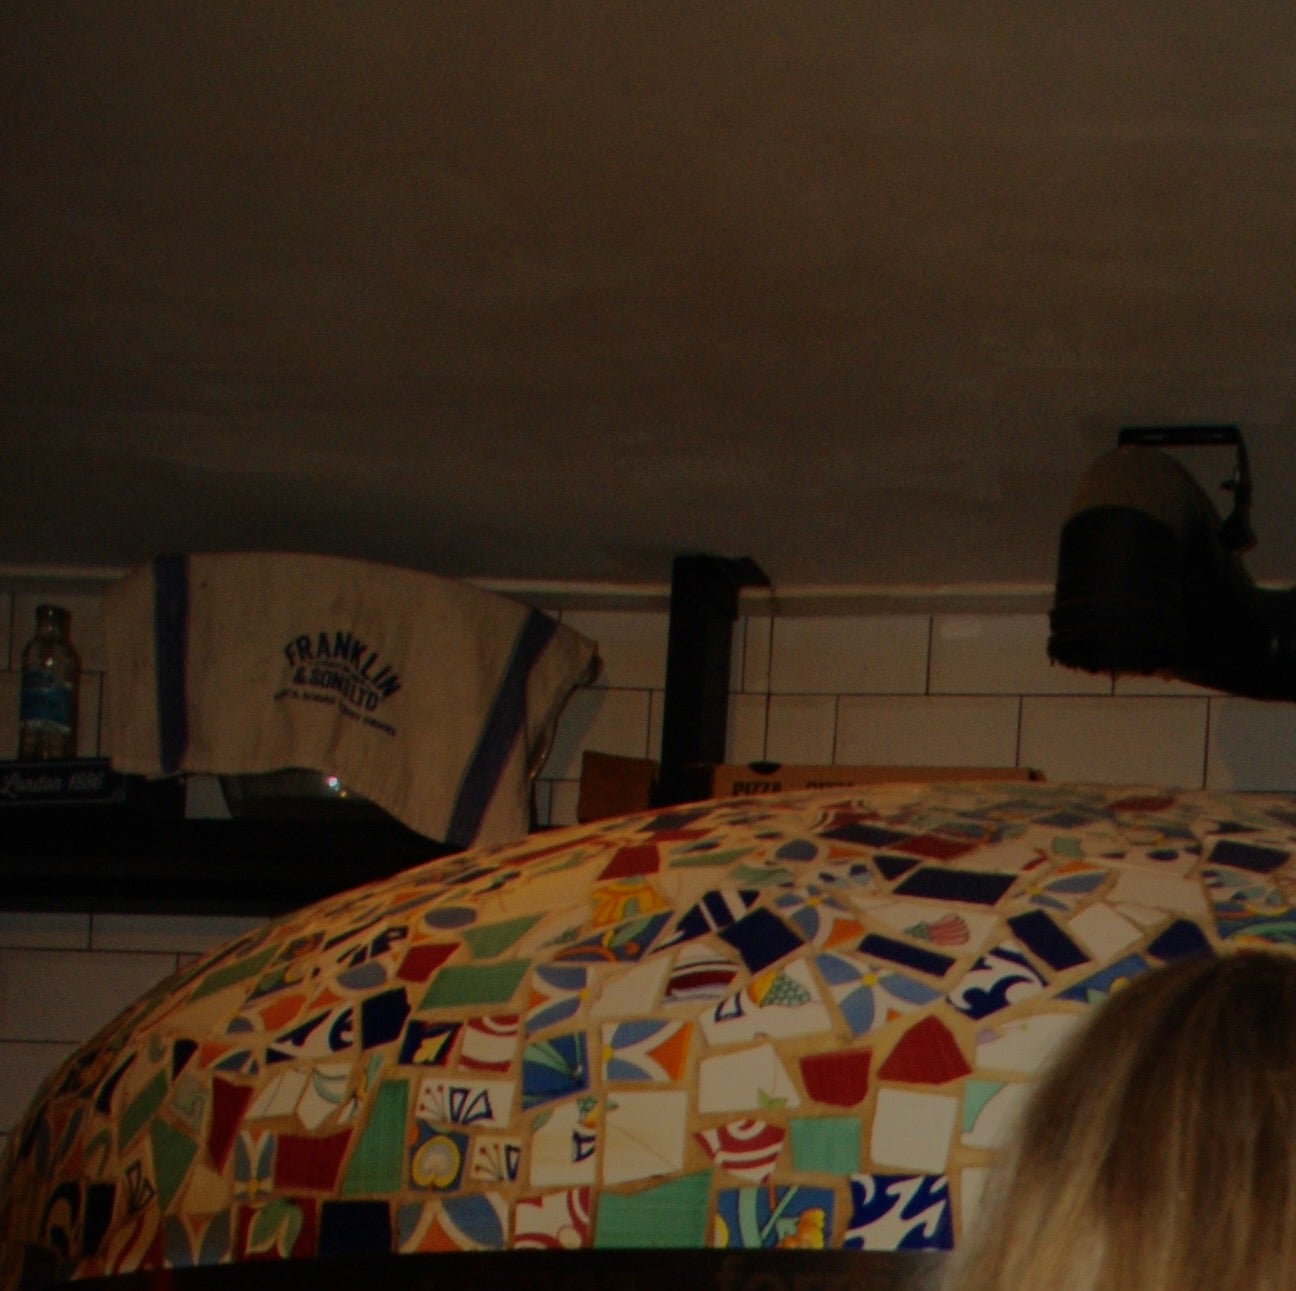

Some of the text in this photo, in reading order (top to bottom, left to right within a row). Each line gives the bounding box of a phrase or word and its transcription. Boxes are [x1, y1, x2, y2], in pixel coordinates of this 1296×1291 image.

[284, 632, 401, 697] FRANKLIN
[350, 686, 379, 711] LTD
[732, 781, 782, 796] PIZZA
